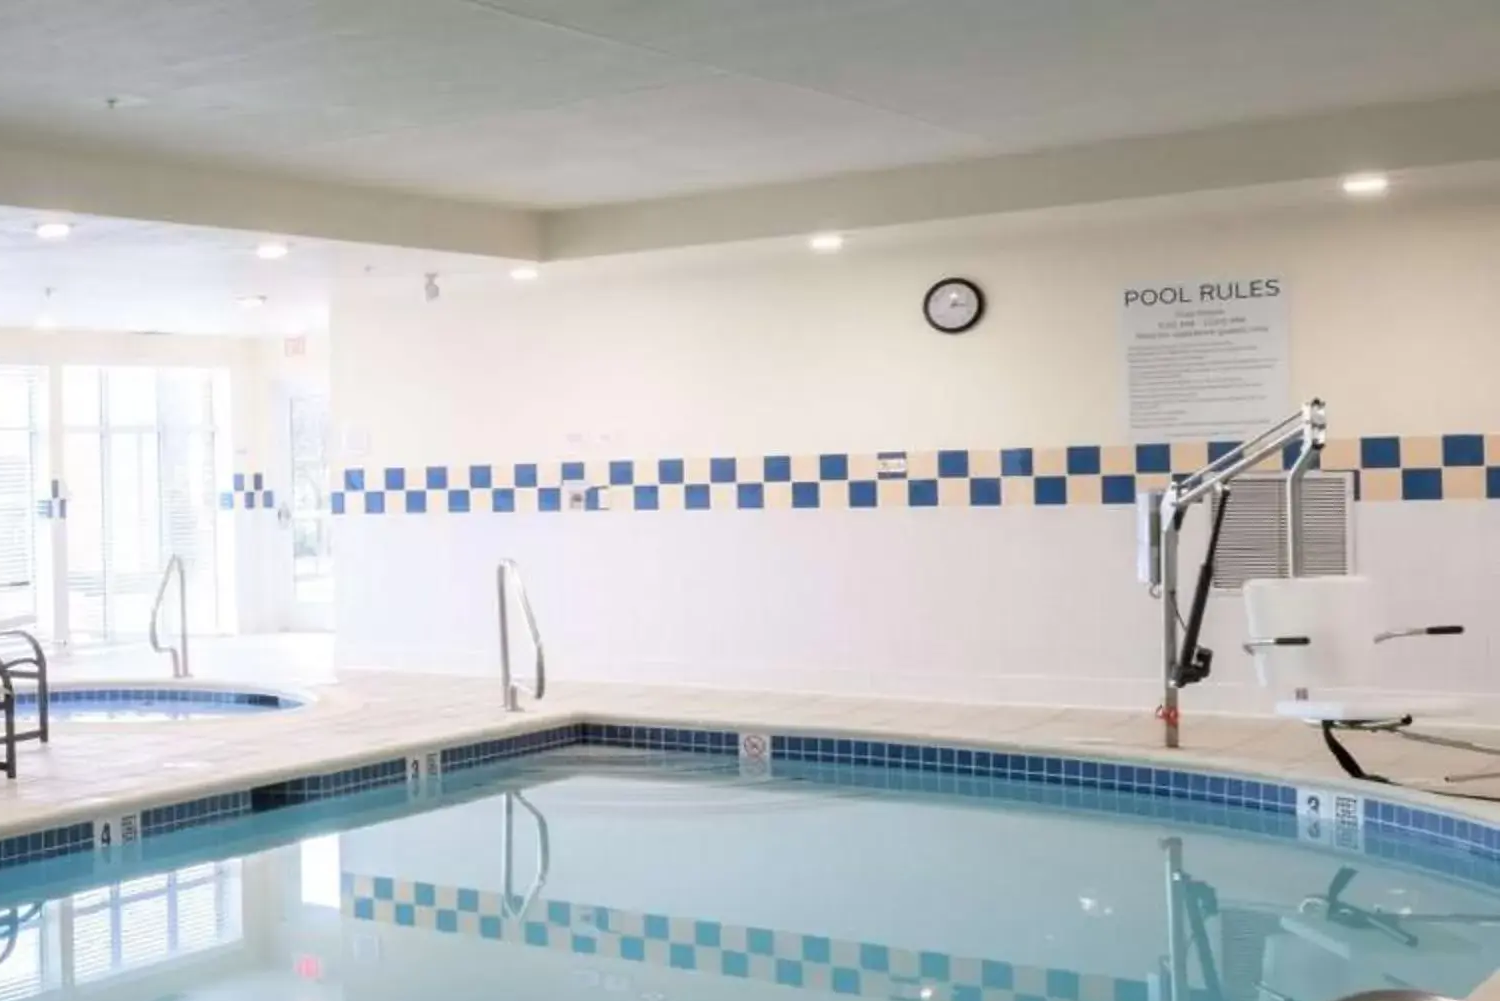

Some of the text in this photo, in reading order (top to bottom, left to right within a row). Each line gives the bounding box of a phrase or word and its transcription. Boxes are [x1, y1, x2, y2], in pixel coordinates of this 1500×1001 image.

[1124, 278, 1281, 307] POOL RULES
[102, 822, 111, 846] 4
